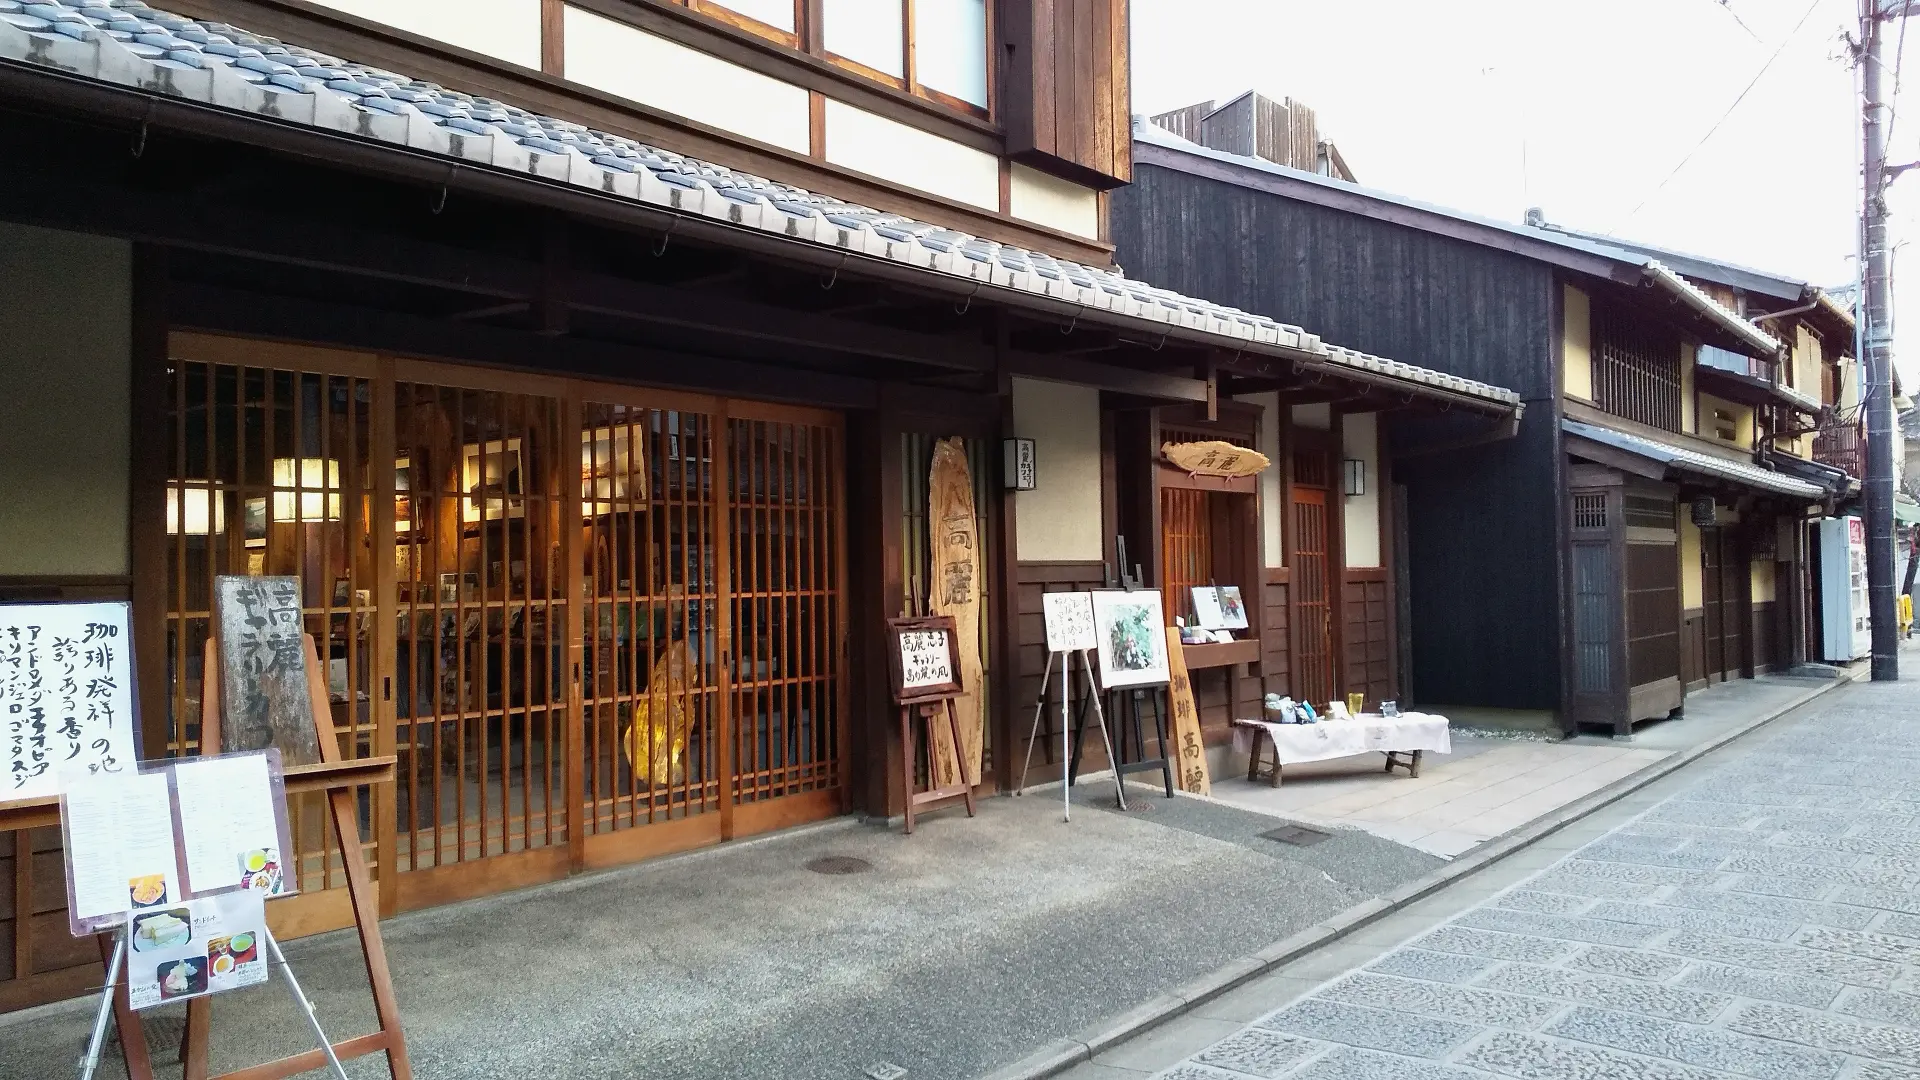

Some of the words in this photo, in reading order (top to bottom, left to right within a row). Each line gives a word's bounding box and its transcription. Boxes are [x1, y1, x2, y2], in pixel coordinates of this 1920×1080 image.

[1196, 449, 1241, 471] 高麗
[267, 584, 303, 678] 高麗
[52, 636, 83, 761] 誇りある香り
[81, 622, 123, 775] 珈琲発祥の地
